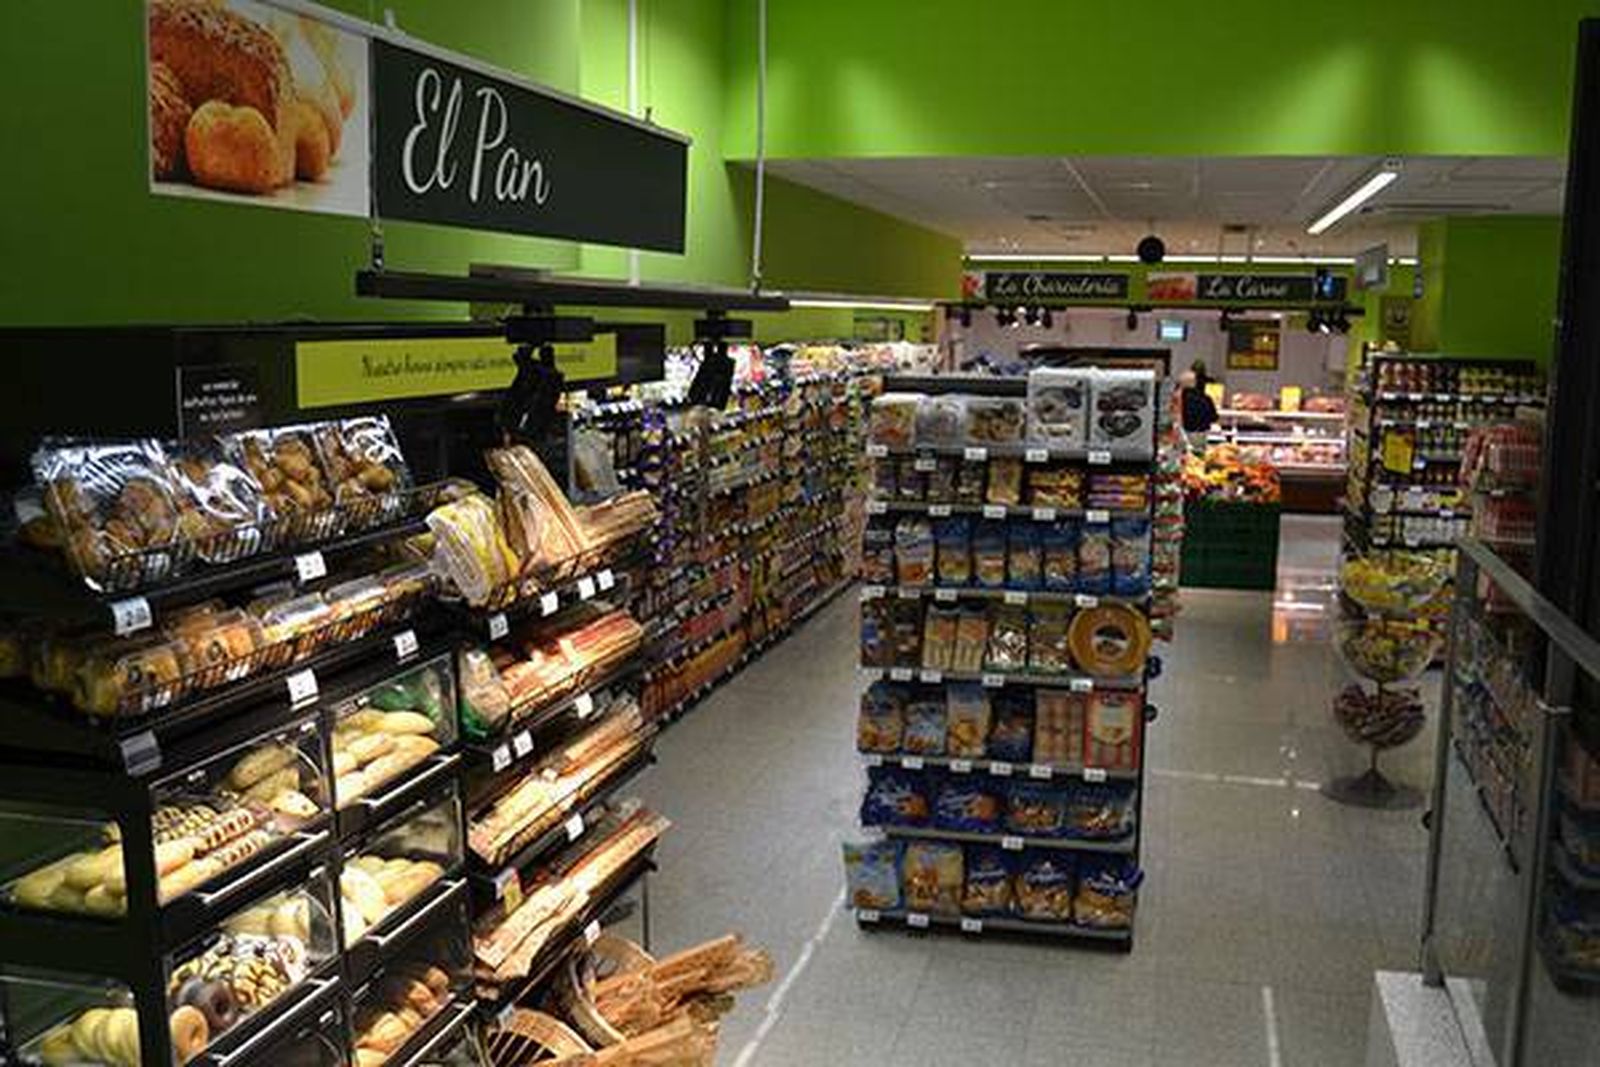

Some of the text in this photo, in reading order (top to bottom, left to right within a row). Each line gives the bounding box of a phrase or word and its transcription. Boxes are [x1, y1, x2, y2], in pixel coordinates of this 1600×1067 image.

[402, 68, 549, 204] El Pan
[994, 274, 1018, 296] La
[1206, 275, 1287, 297] La Carne
